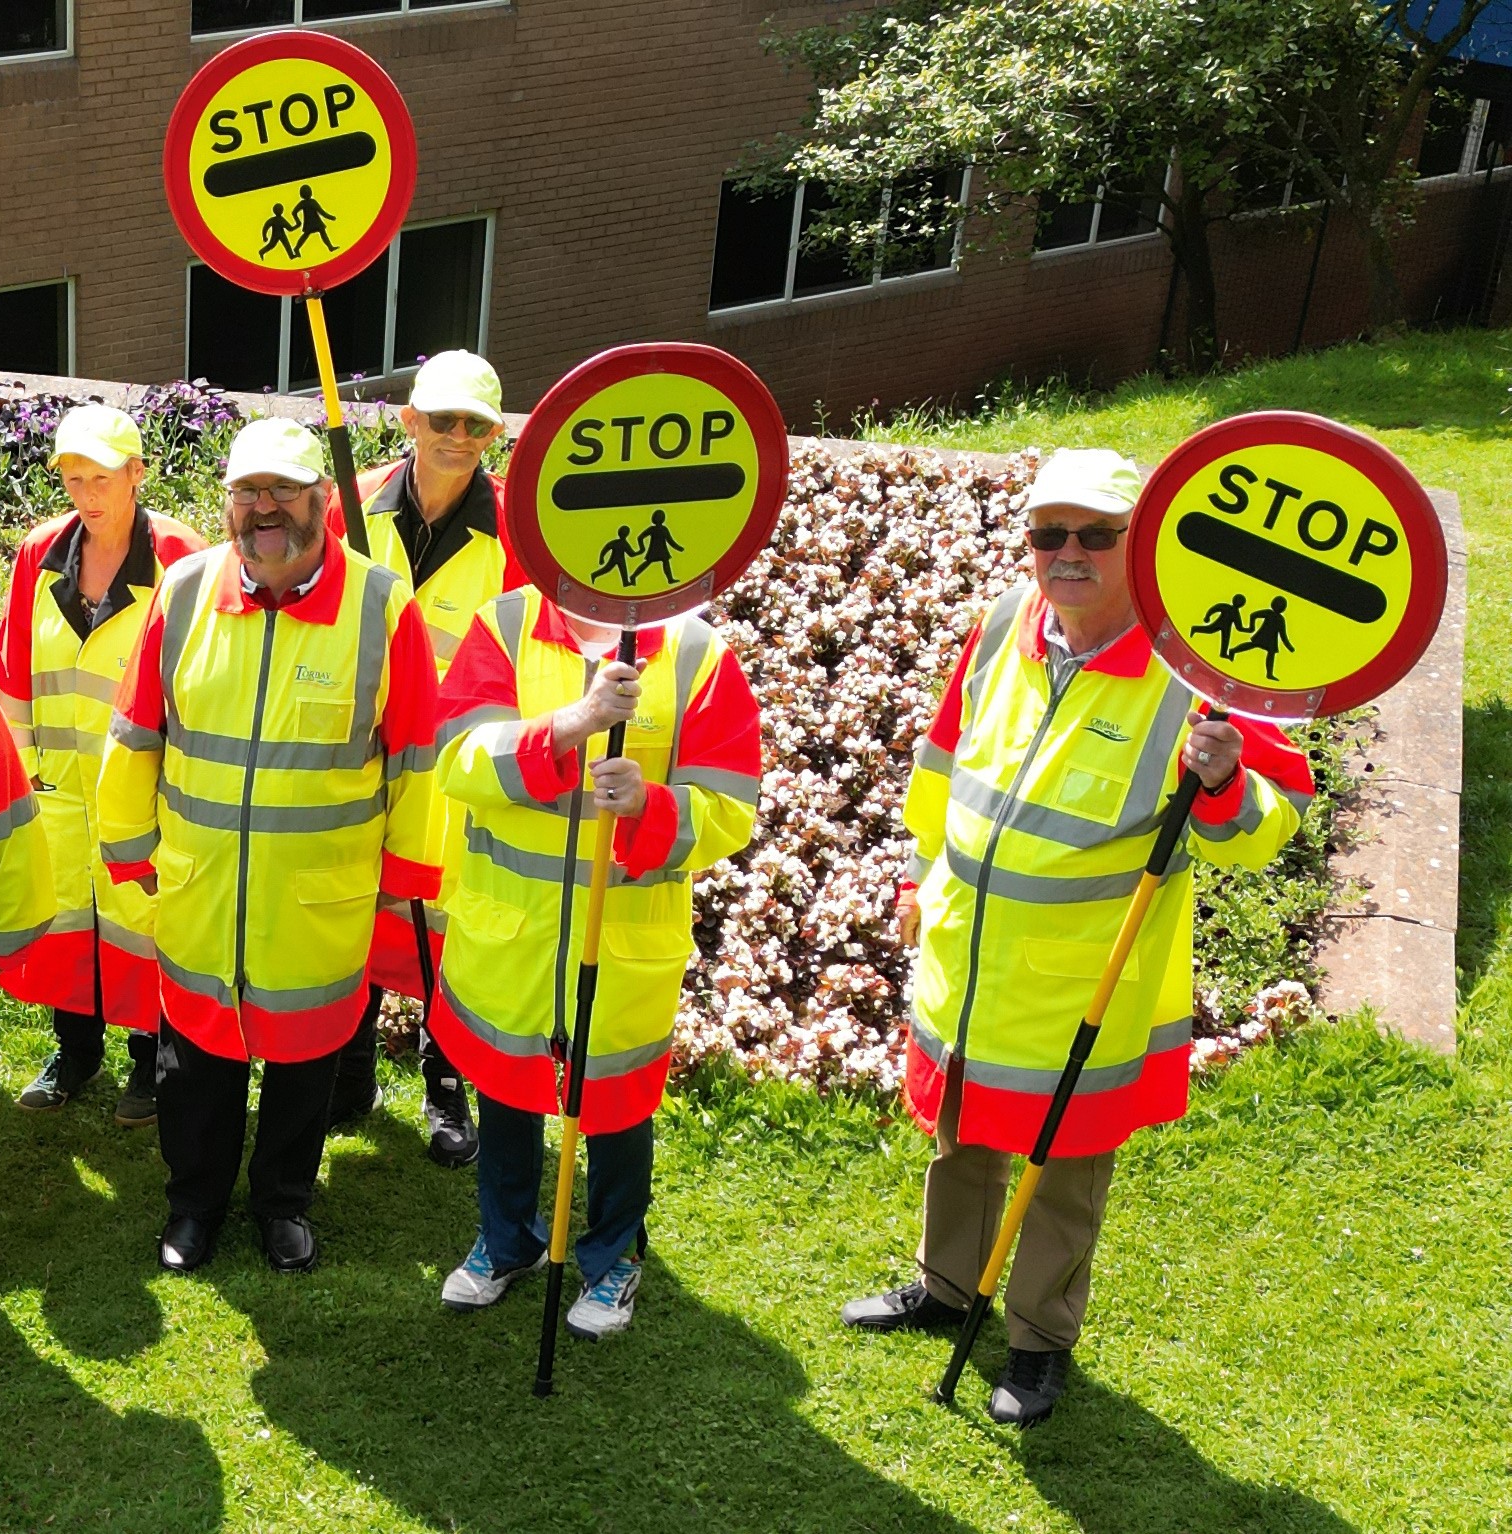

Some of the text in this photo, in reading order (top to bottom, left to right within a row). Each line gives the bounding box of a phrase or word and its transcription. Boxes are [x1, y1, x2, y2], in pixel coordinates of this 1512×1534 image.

[209, 84, 356, 154] STOP
[566, 410, 737, 466] STOP
[1207, 464, 1400, 567] STOP
